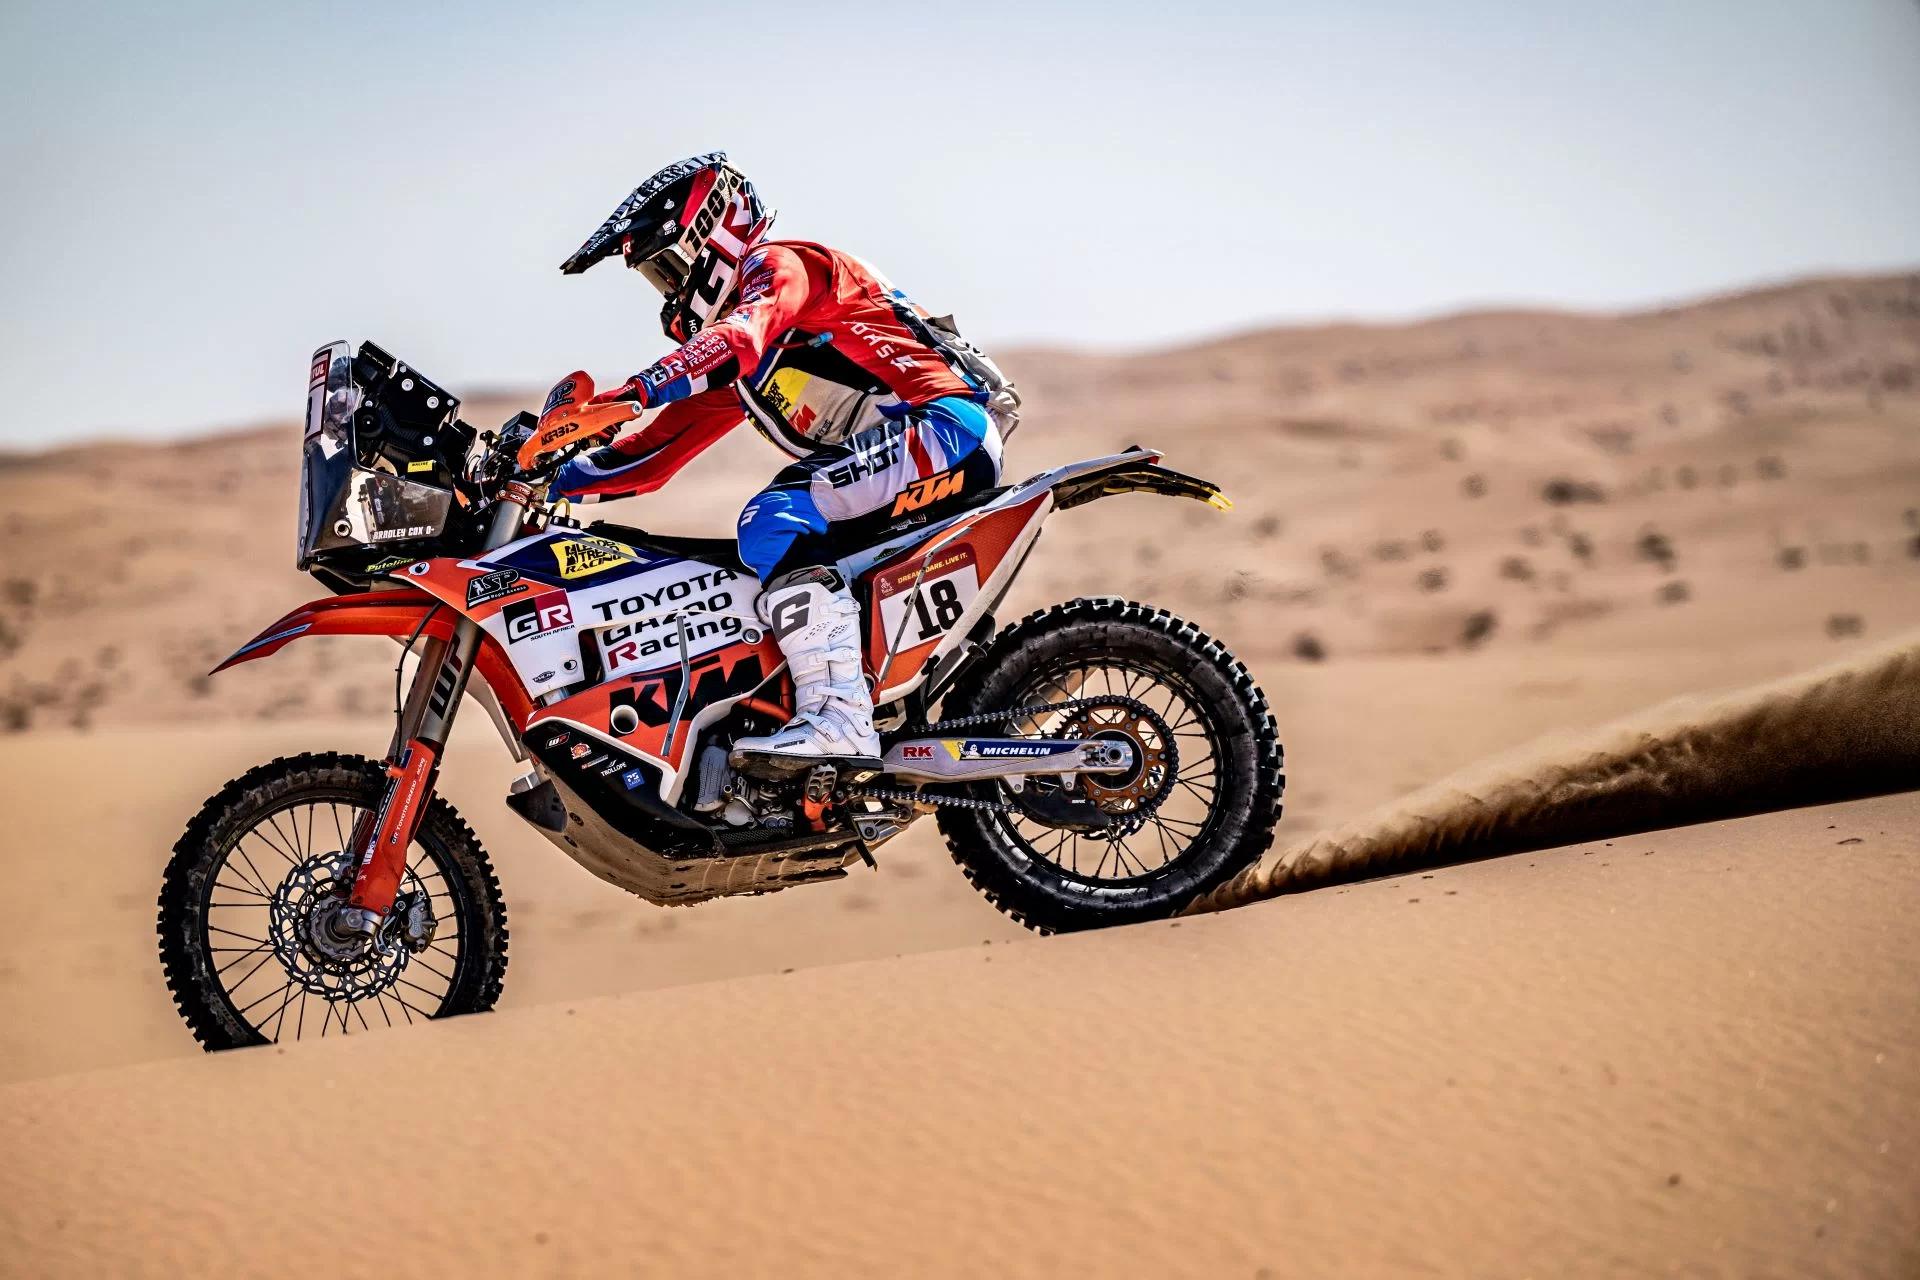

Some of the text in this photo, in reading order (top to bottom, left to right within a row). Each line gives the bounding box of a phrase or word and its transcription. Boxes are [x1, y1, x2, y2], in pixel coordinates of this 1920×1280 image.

[684, 168, 741, 254] 100%
[688, 340, 728, 367] Racing
[827, 442, 900, 489] SHOT
[890, 469, 965, 518] KTM
[373, 528, 406, 540] BRADLEY
[408, 527, 424, 536] COX
[946, 556, 959, 565] LIVE
[592, 568, 738, 621] TOYOTA
[771, 590, 812, 643] G
[904, 580, 964, 641] 18
[508, 603, 572, 640] GR
[530, 624, 575, 641] SOUTH AFRICA
[602, 592, 733, 647] GAZOO
[607, 616, 742, 670] Racing
[609, 653, 764, 737] KTM
[600, 761, 627, 777] TROLLOPE
[903, 746, 932, 758] RK
[982, 746, 1051, 756] MICHELIN
